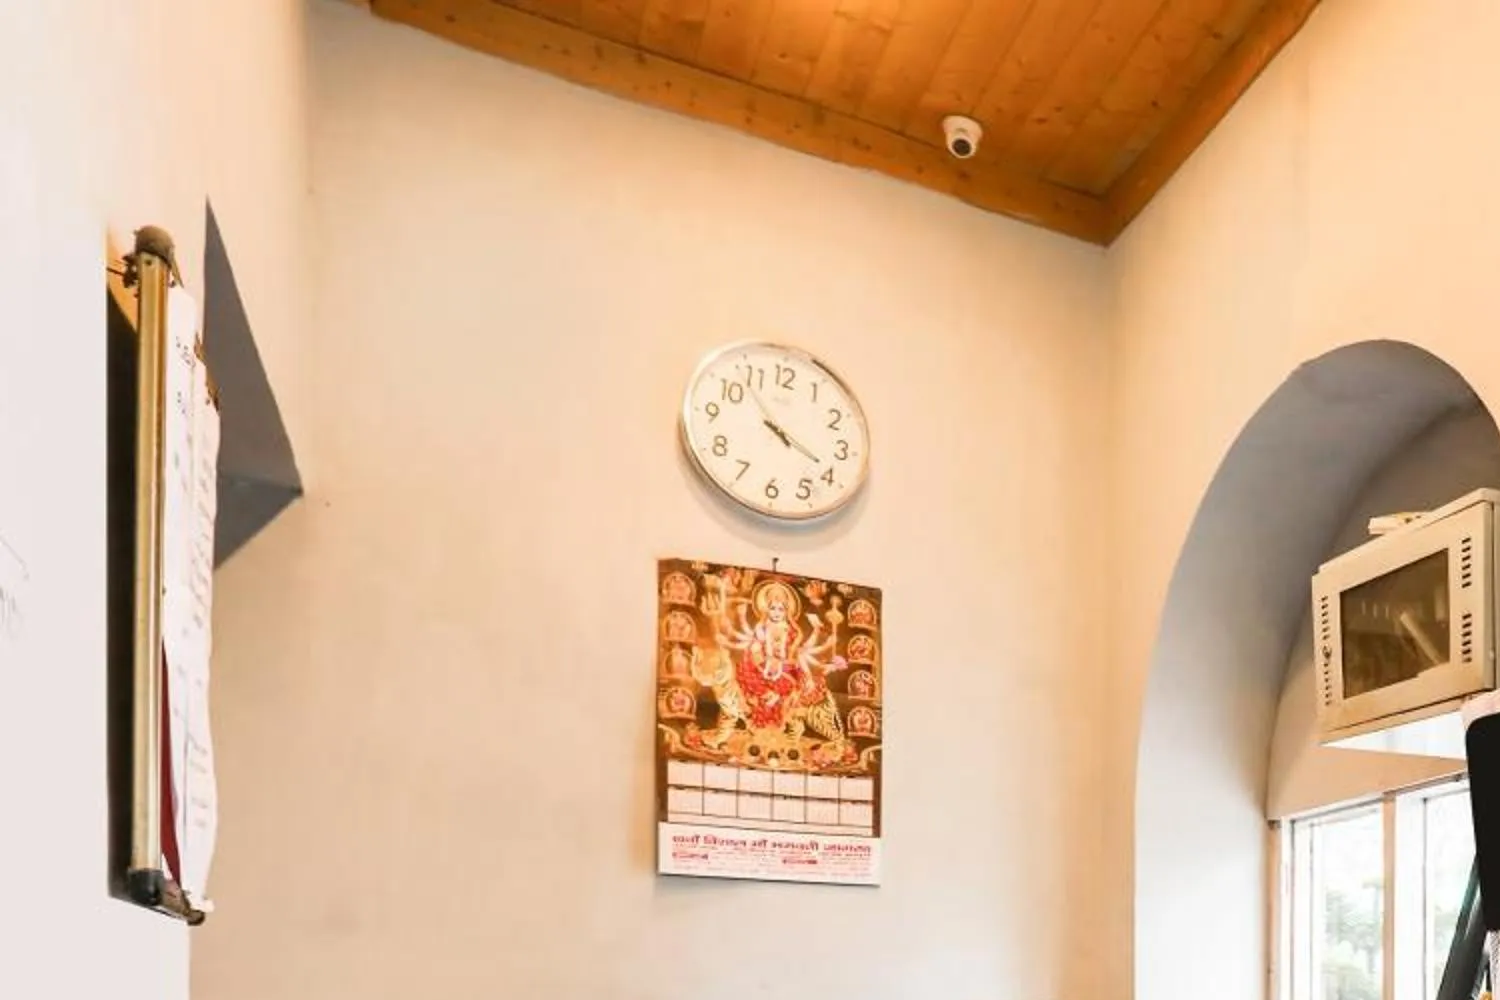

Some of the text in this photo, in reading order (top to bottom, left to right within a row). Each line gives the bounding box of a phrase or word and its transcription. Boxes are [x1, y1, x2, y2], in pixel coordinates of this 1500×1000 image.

[745, 364, 764, 390] 11
[775, 364, 797, 390] 12
[720, 378, 744, 404] 10
[810, 382, 818, 402] 1
[705, 402, 720, 422] 9
[828, 409, 841, 431] 2
[712, 435, 728, 457] 8
[834, 440, 849, 461] 3
[735, 459, 750, 480] 7
[820, 467, 835, 485] 4
[765, 478, 779, 499] 6
[796, 478, 813, 500] 5
